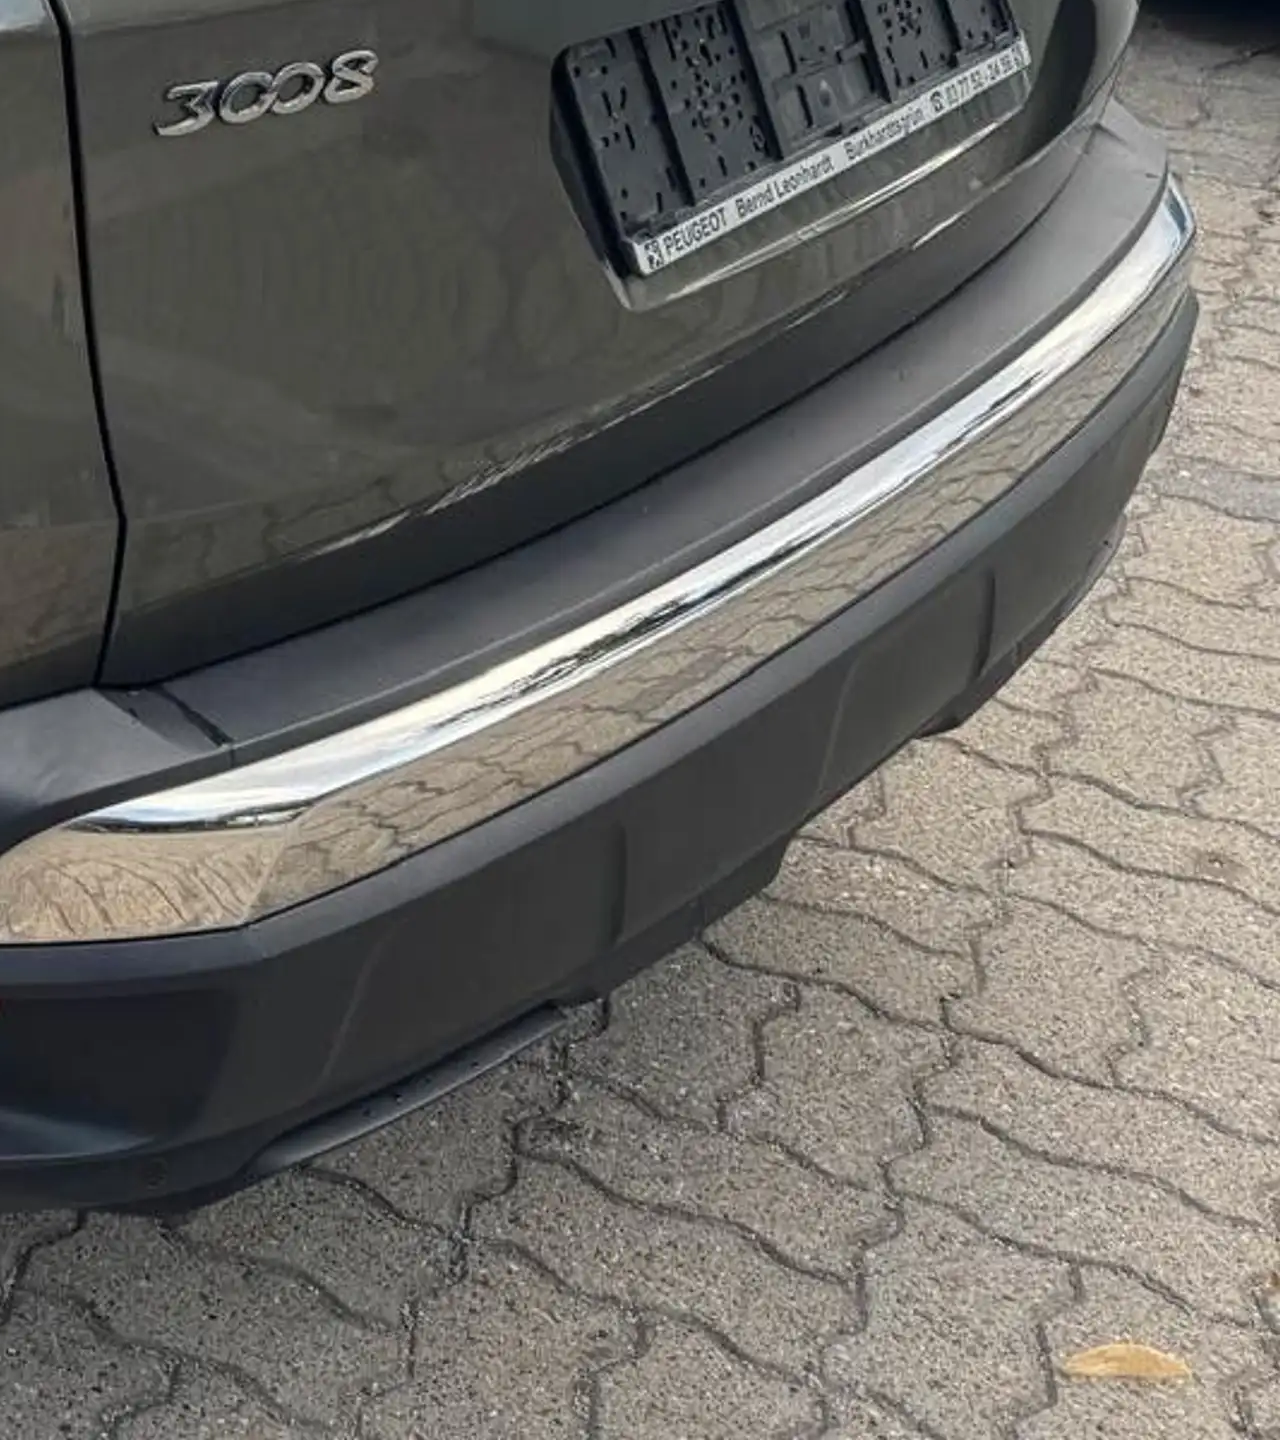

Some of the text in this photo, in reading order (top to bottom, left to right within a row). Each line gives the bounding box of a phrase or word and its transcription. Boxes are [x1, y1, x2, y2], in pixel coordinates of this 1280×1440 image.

[153, 49, 379, 136] 3008
[662, 207, 728, 256] PEUGEOT
[735, 183, 775, 219] Bernd
